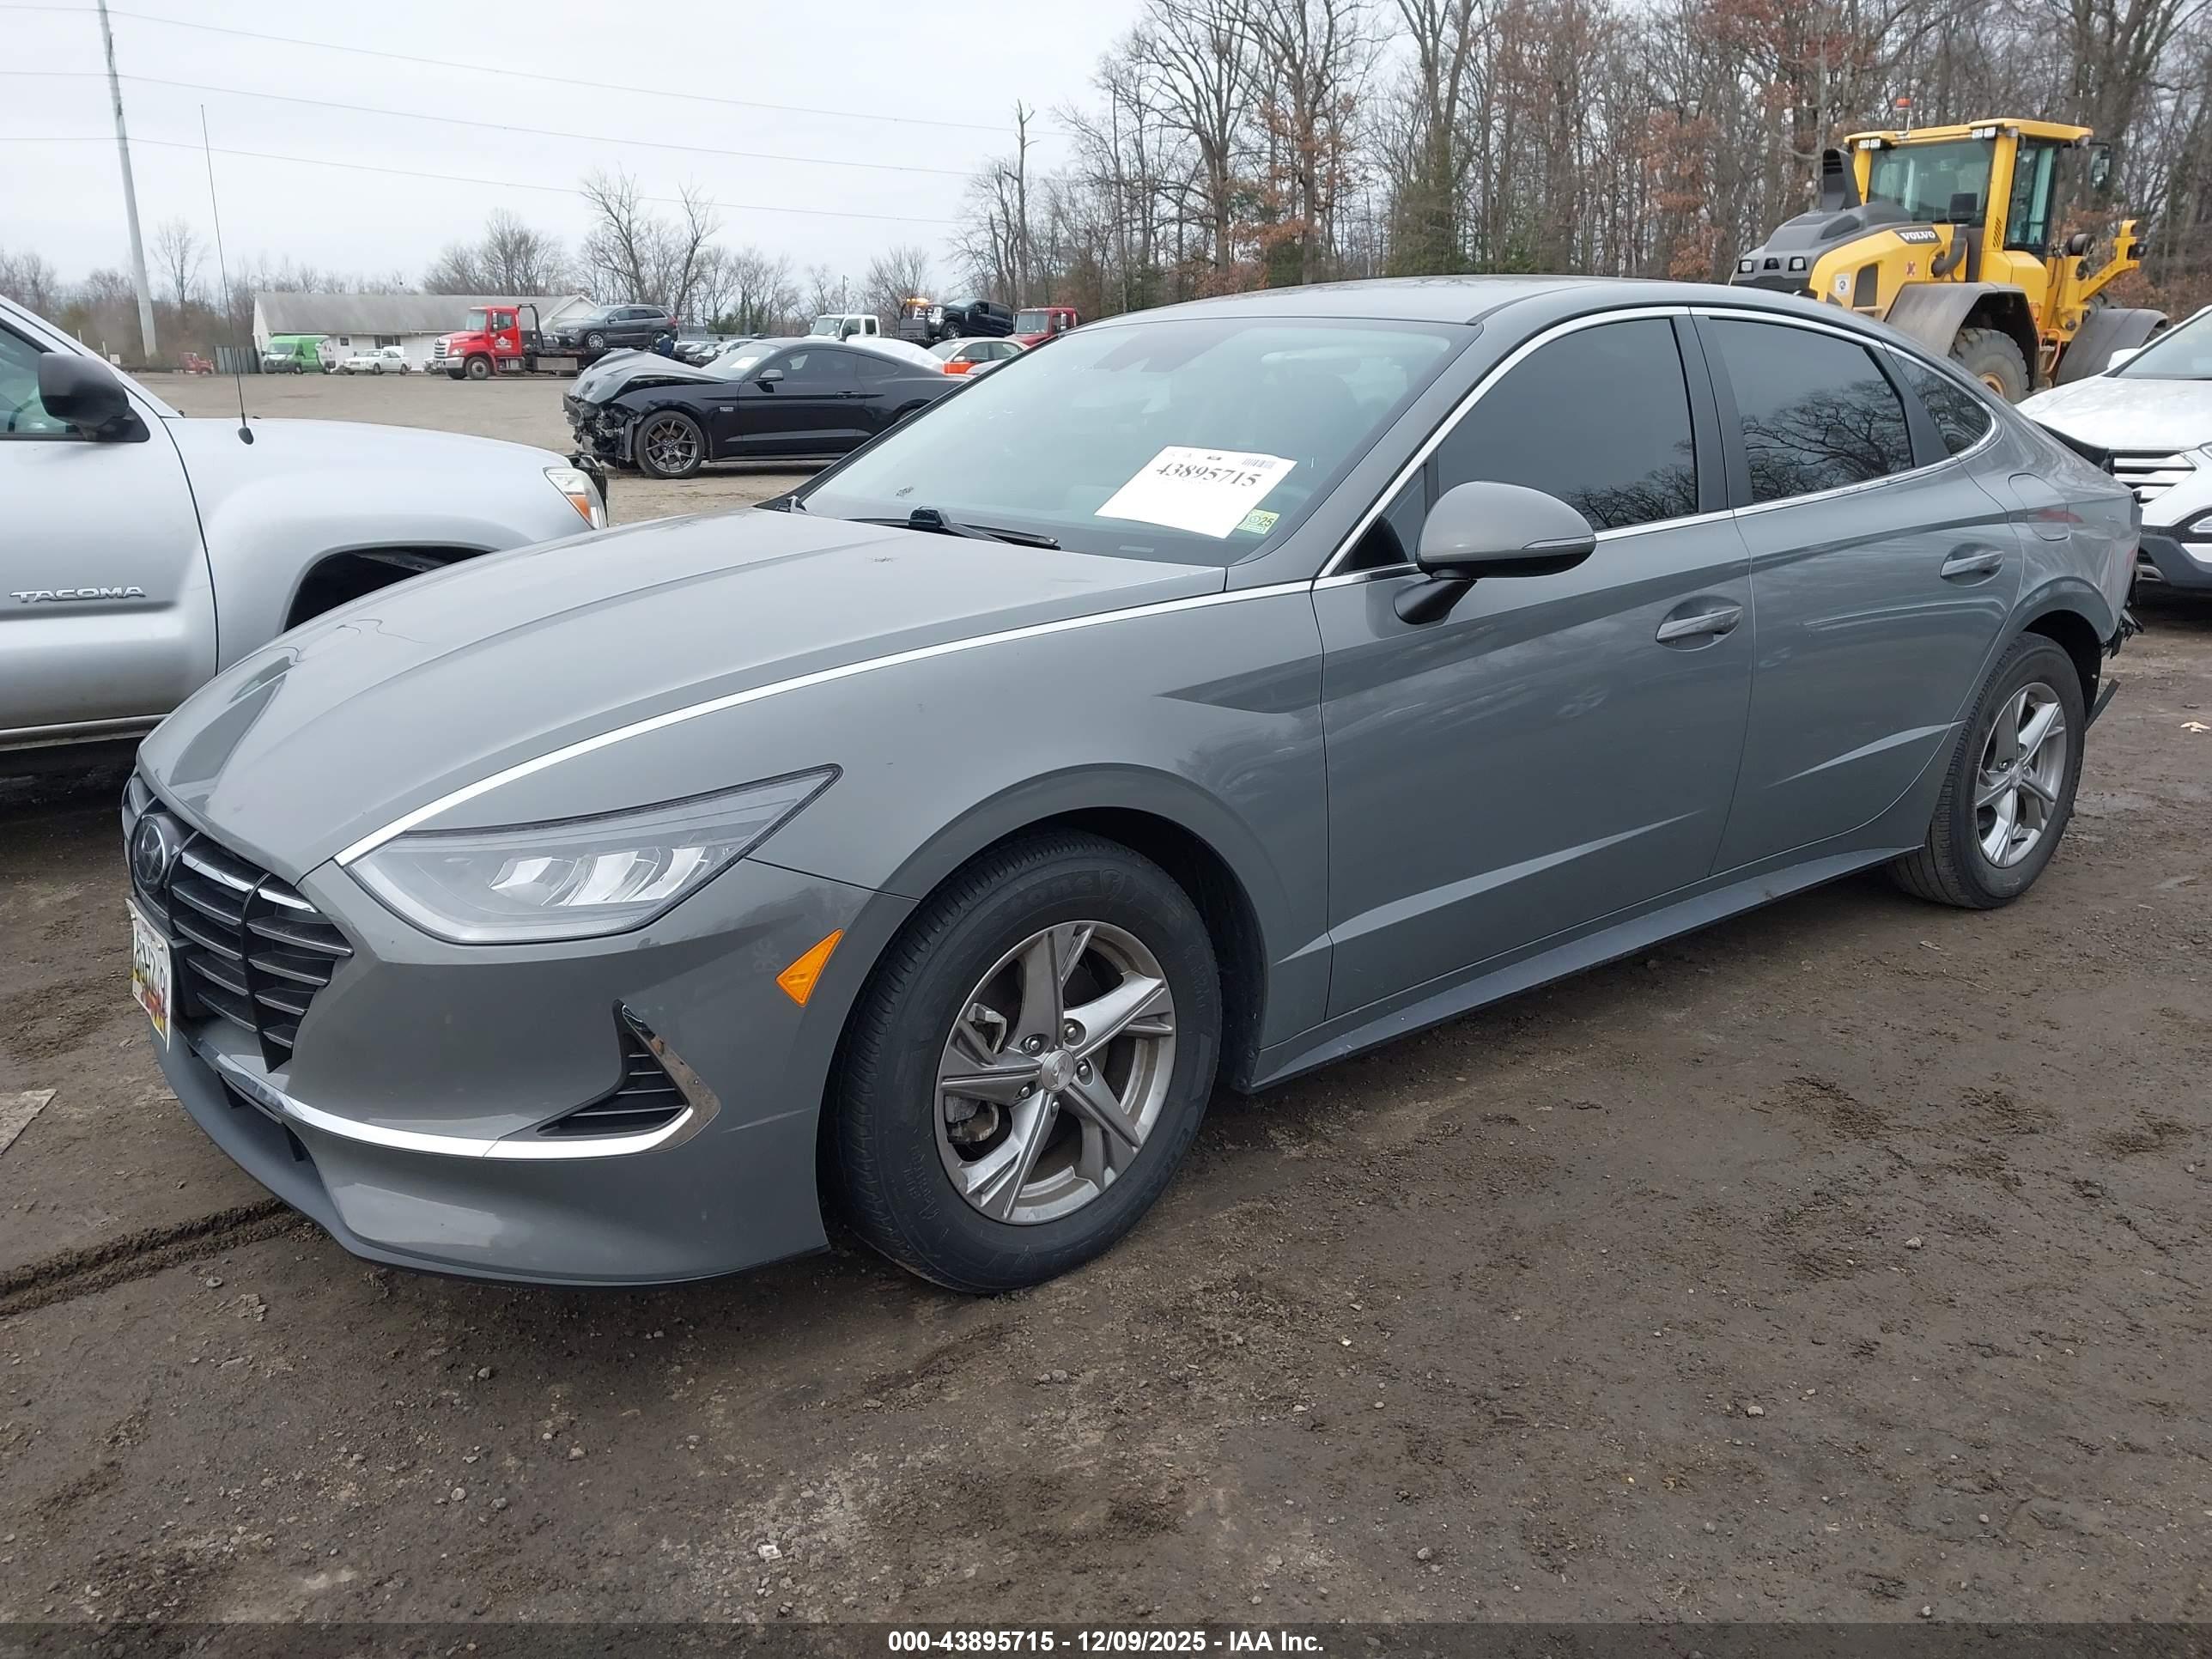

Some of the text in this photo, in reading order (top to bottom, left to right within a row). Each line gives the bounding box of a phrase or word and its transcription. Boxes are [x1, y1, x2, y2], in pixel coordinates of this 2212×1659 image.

[1899, 230, 1936, 241] VOLVO
[1156, 462, 1261, 487] 43895715
[1257, 516, 1274, 527] 25
[9, 586, 147, 603] TACOMA
